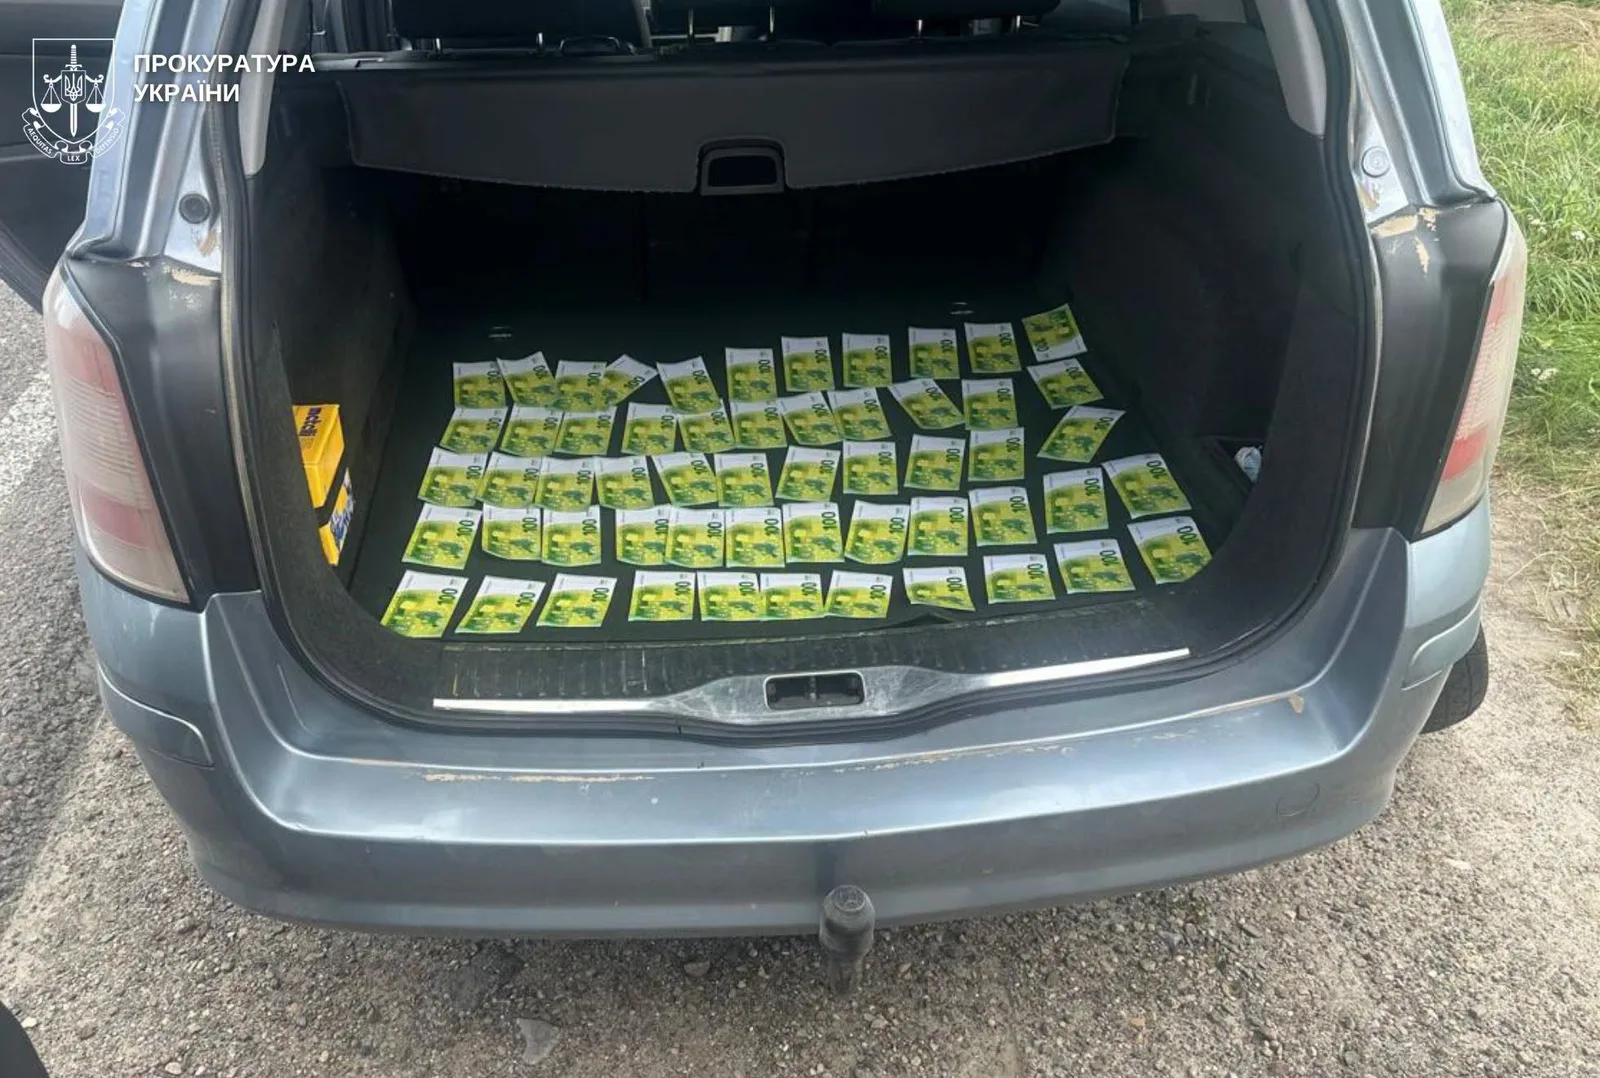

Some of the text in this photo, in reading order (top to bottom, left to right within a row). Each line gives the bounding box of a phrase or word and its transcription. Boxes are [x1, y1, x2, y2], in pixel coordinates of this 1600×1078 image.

[1146, 460, 1166, 479] 100
[1084, 478, 1101, 497] 100
[821, 512, 837, 530] 100
[949, 507, 965, 524] 100
[456, 519, 474, 536] 100
[522, 517, 537, 532] 100
[582, 519, 597, 535] 100
[655, 518, 669, 534] 100
[707, 521, 722, 538] 100
[764, 518, 780, 536] 100
[889, 517, 905, 534] 100
[1176, 525, 1198, 544] 100
[1099, 550, 1118, 566] 100
[1027, 563, 1045, 580] 100
[674, 581, 692, 595] 100
[739, 581, 756, 596] 100
[801, 582, 818, 596] 100
[869, 584, 887, 599] 100
[946, 577, 963, 592] 100
[437, 588, 458, 606] 100
[515, 591, 536, 608] 100
[591, 587, 610, 604] 100
